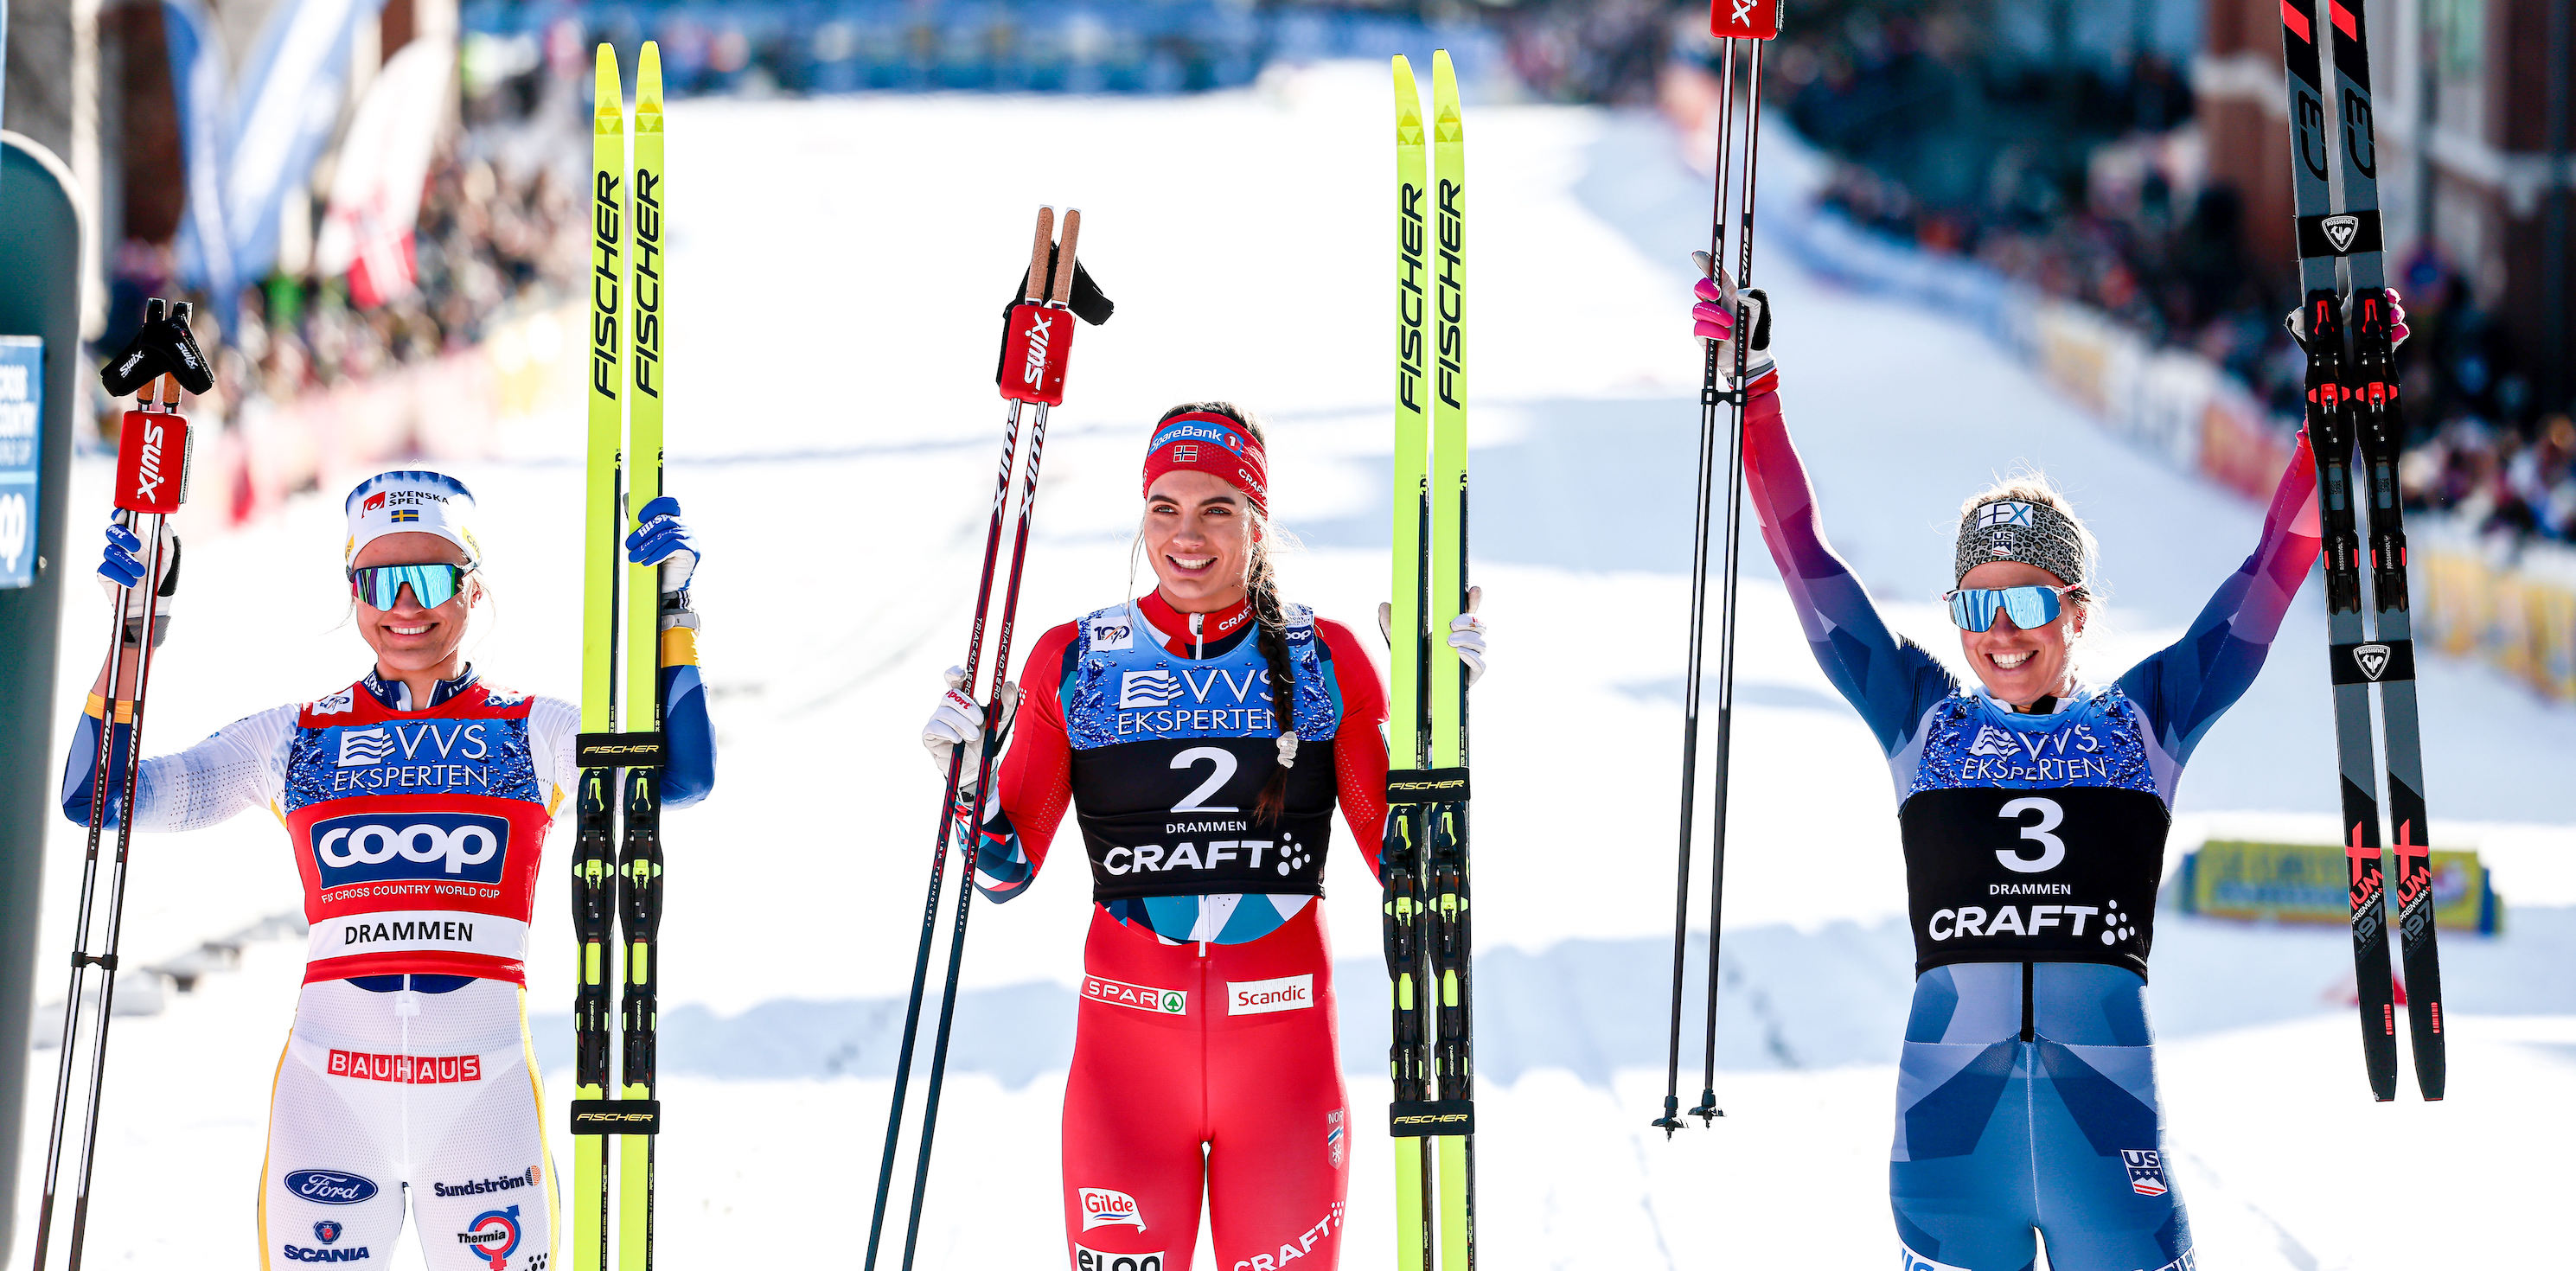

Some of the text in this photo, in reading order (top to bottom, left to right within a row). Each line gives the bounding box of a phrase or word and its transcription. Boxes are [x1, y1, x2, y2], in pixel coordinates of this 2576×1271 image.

[594, 169, 619, 400] FISCHER
[636, 168, 660, 399] FISCHER
[1438, 178, 1461, 410] FISCHER
[1400, 182, 1423, 414] FISCHER
[1151, 425, 1222, 451] SpareBank
[389, 490, 449, 505] SVENSKA
[389, 497, 423, 506] SPEL
[1218, 603, 1253, 631] CRAFT
[1285, 630, 1311, 641] oop
[946, 689, 973, 710] port
[395, 723, 488, 760] VVS
[582, 745, 660, 754] FISCHER
[2018, 724, 2100, 762] VVS
[334, 765, 489, 791] EKSPERTEN
[1169, 746, 1239, 813] 2
[1961, 757, 2108, 781] EKSPERTEN
[1388, 779, 1465, 790] FISCHER
[1166, 821, 1247, 834] DRAMMEN
[1995, 796, 2066, 873] 3
[318, 824, 498, 873] coop
[1103, 840, 1274, 876] CRAFT
[322, 885, 501, 904] FIS CROSS COUNTRY WORLD CUP
[1990, 884, 2071, 895] DRAMMEN
[1928, 905, 2099, 942] CRAFT
[2354, 902, 2383, 943] 197
[2401, 899, 2431, 942] 197
[345, 921, 474, 945] DRAMMEN
[1088, 980, 1158, 1006] SPAR
[1238, 986, 1306, 1006] Scandic
[330, 1052, 478, 1081] BAUHAUS
[576, 1113, 654, 1121] FISCHER
[1328, 1110, 1344, 1124] NOR
[1393, 1114, 1468, 1124] FISCHER
[2124, 1151, 2160, 1167] US
[301, 1176, 361, 1201] Ford
[434, 1174, 525, 1198] Sundström
[1084, 1192, 1134, 1214] Gilde
[457, 1229, 506, 1243] Thermia
[284, 1244, 370, 1263] SCANIA
